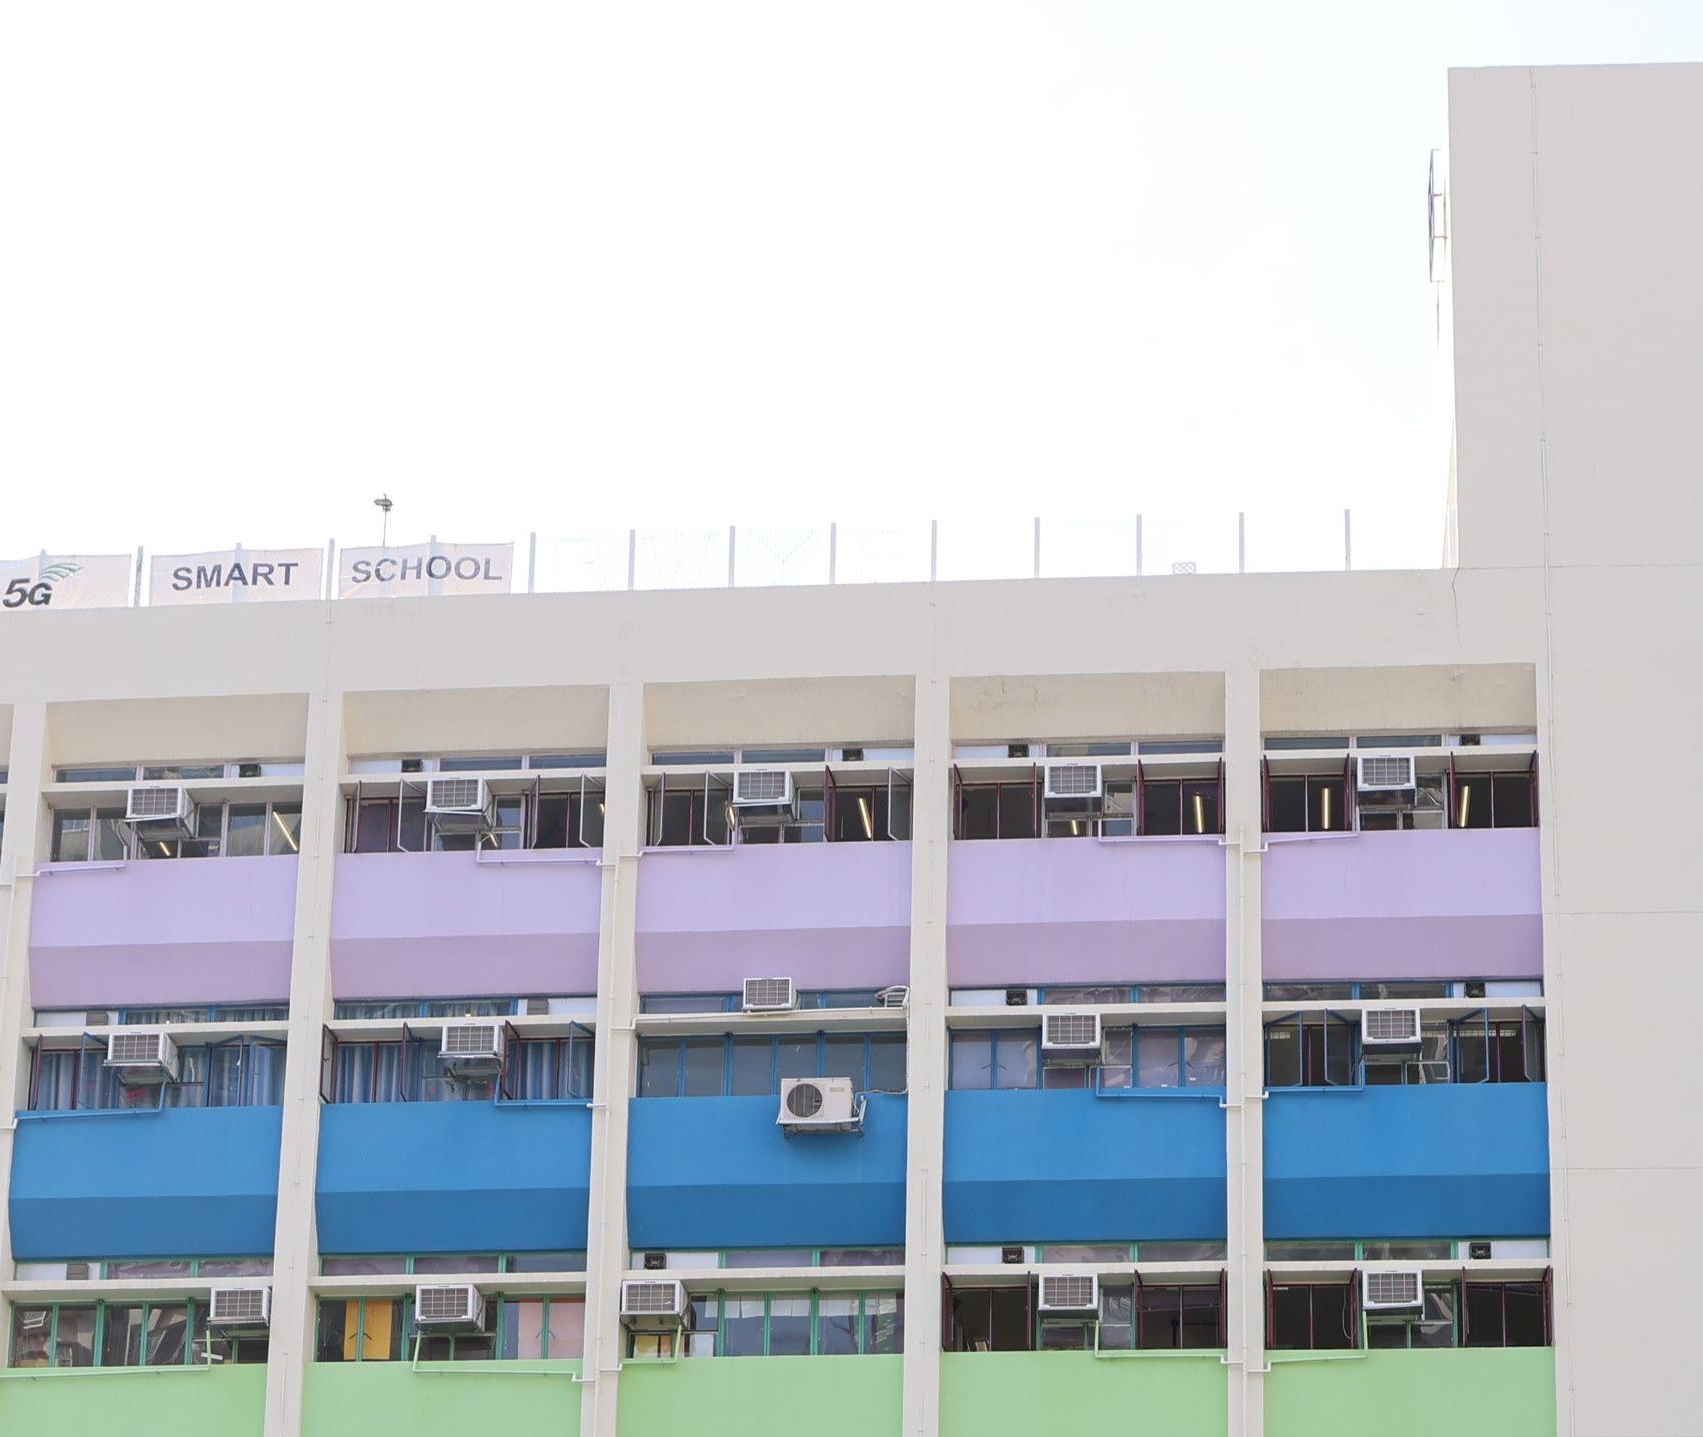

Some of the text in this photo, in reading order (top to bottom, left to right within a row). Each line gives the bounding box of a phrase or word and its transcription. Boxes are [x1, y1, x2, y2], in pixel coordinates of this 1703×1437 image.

[2, 553, 503, 608] 5G SMART SCHOOL
